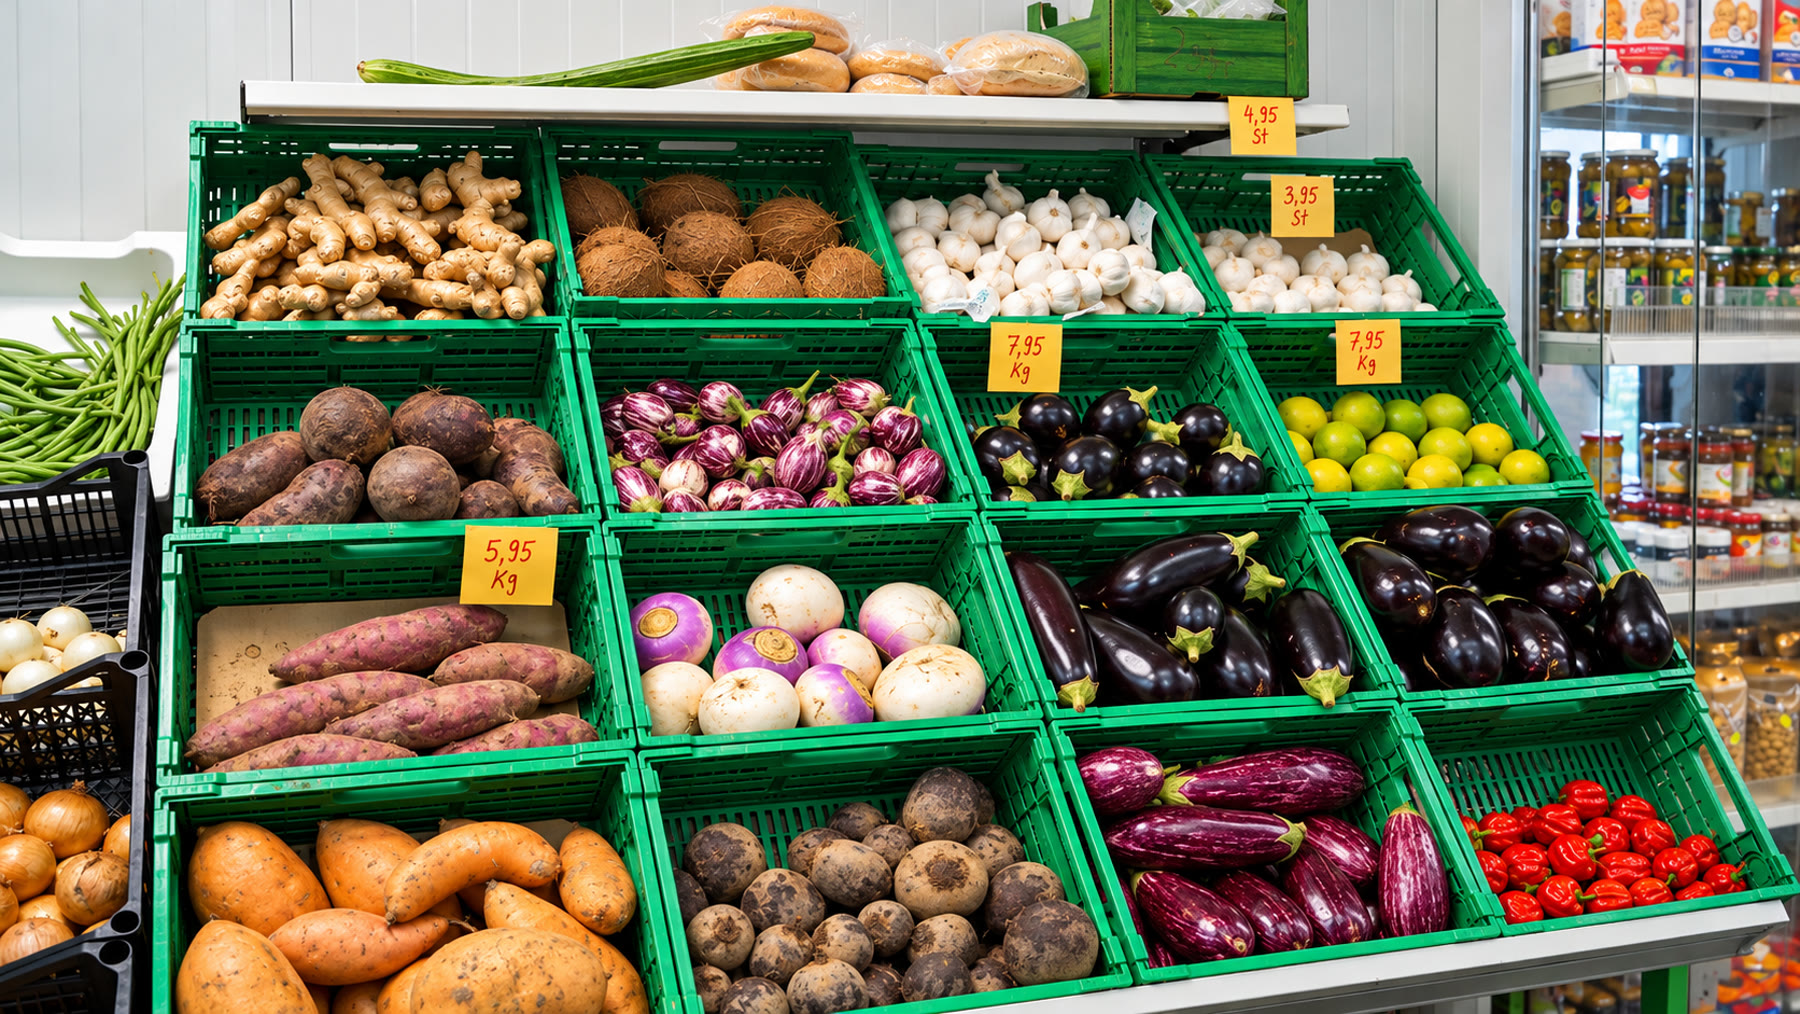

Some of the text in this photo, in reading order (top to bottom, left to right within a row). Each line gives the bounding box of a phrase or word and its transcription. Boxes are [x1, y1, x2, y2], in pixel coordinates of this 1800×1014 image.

[1243, 104, 1279, 127] 4,95
[1251, 127, 1269, 145] St
[1283, 185, 1319, 207] 3,95
[1290, 208, 1309, 227] St
[1007, 334, 1046, 360] 7,95
[1349, 330, 1385, 354] 7,95
[483, 538, 537, 567] 5,95
